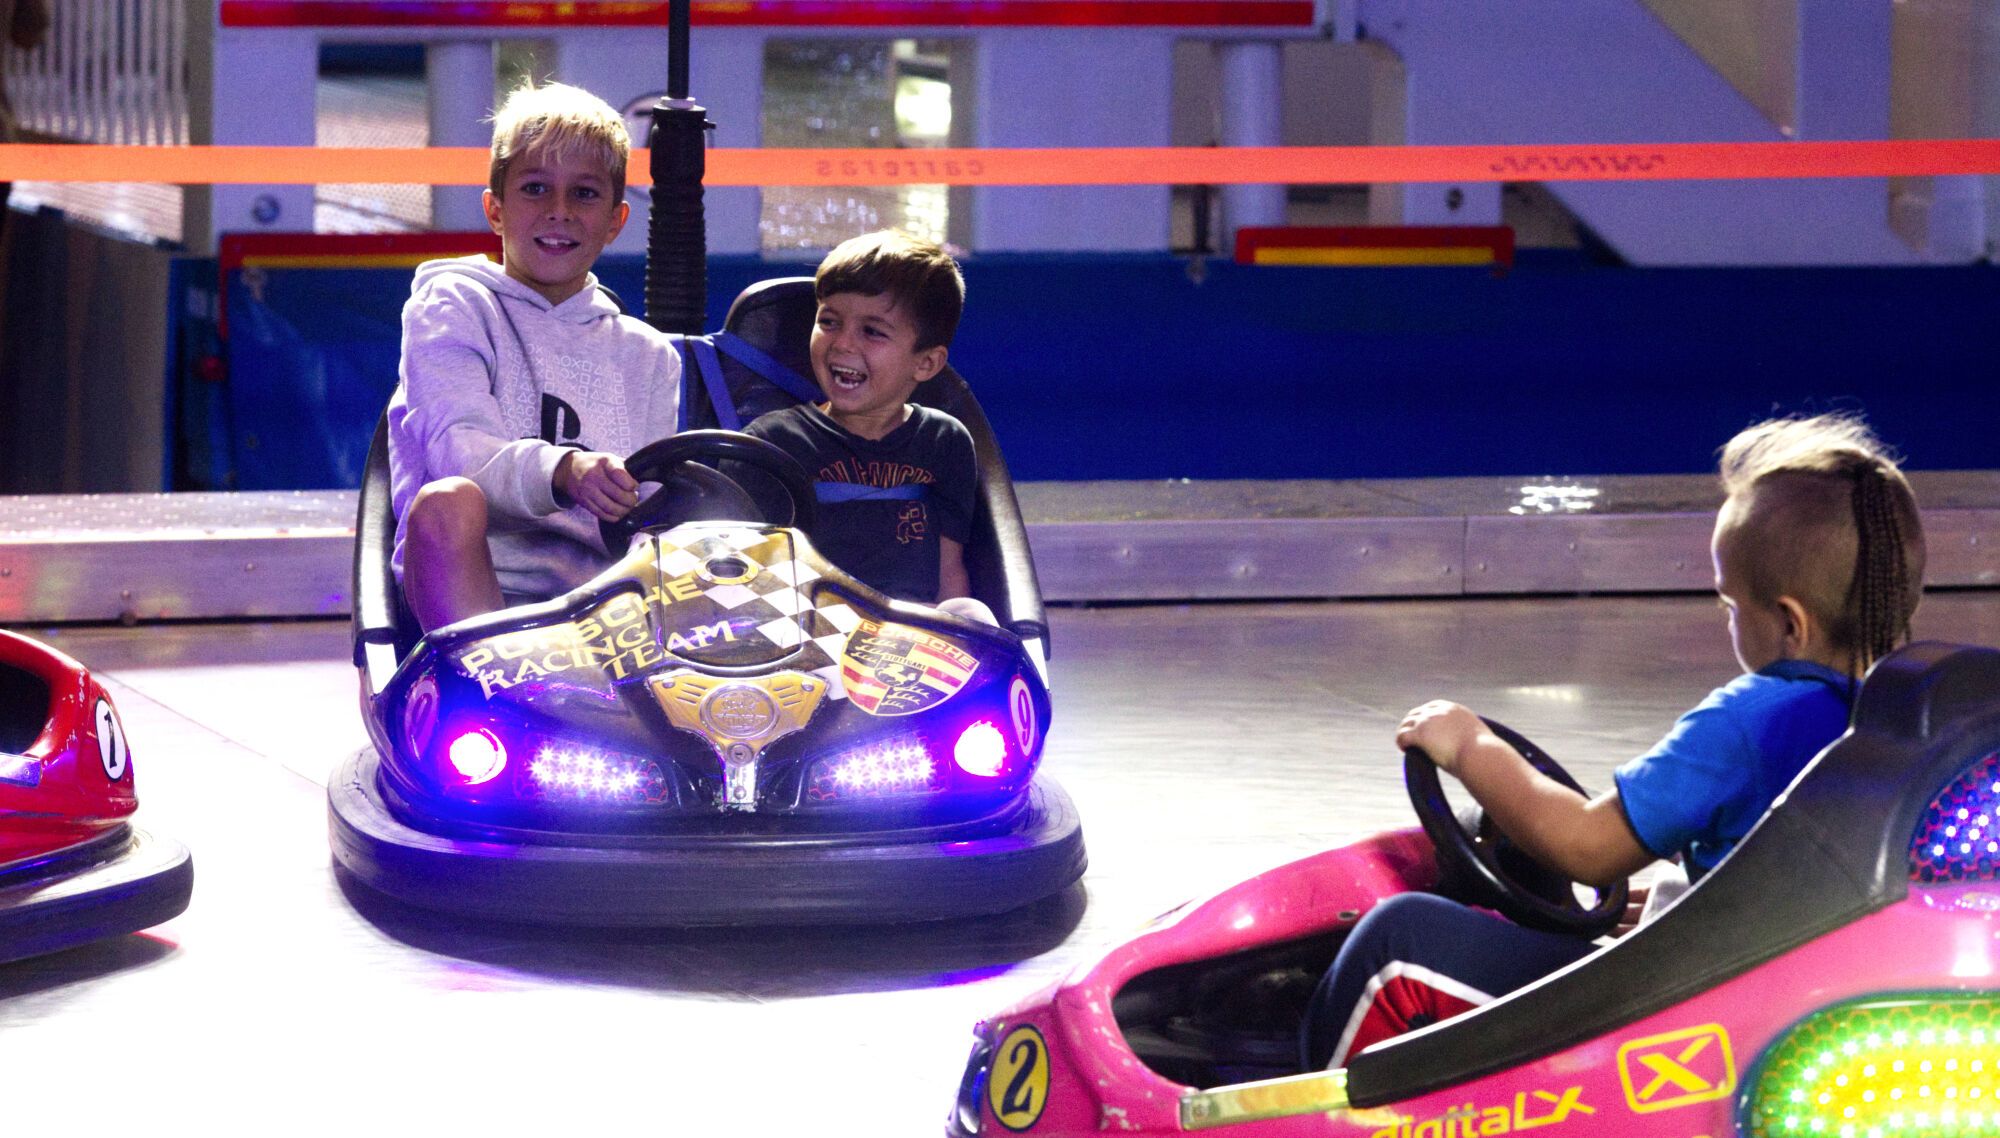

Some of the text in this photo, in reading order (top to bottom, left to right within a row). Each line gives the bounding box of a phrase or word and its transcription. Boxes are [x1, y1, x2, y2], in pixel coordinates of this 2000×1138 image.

[475, 623, 649, 700] RACING
[601, 619, 739, 680] TEAM
[104, 710, 117, 769] 1
[1018, 689, 1031, 746] 9
[1001, 1038, 1038, 1117] 2
